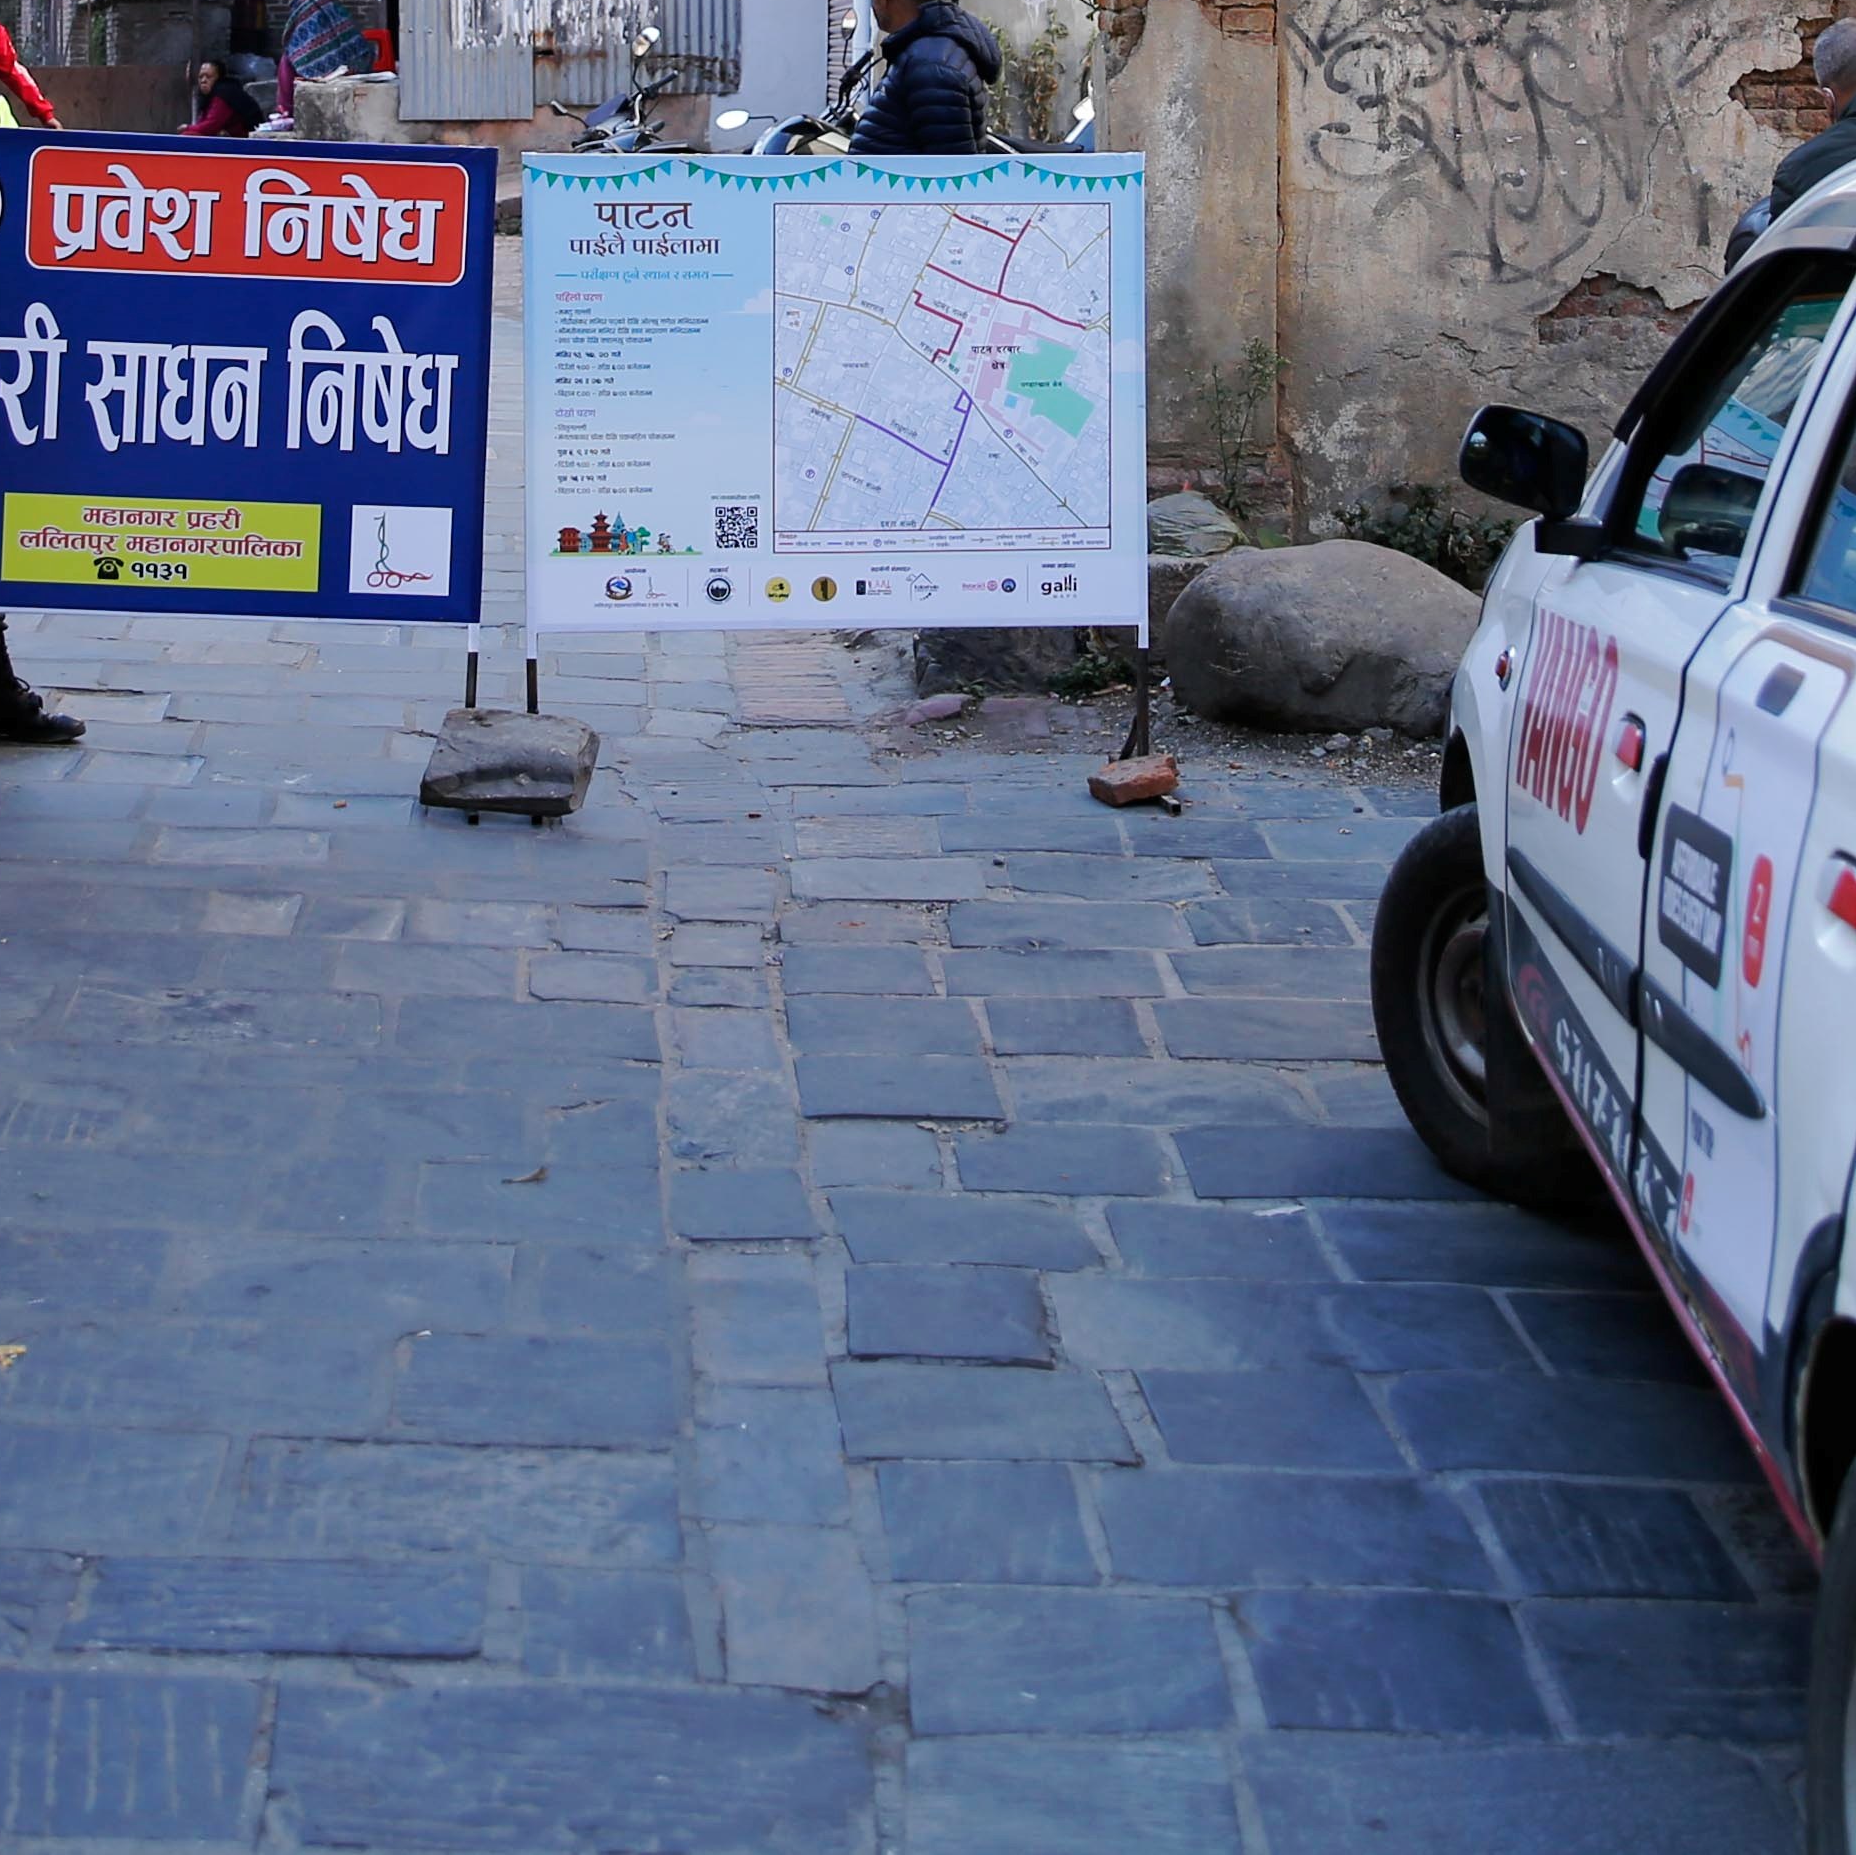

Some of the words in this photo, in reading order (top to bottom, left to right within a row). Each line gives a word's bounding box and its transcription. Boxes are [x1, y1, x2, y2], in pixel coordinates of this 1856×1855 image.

[49, 164, 220, 262] प्रवेश
[242, 167, 444, 266] निषेध
[593, 203, 694, 230] पाटन
[569, 231, 625, 257] पाईलै
[632, 231, 721, 257] पाईलामा
[971, 345, 993, 354] पाटन
[996, 345, 1021, 354] दरबार
[84, 338, 268, 454] साधन
[286, 309, 459, 456] निषेध
[82, 505, 179, 532] महानगर
[185, 505, 241, 533] प्रहरी
[19, 527, 118, 559] ललितपुर
[125, 533, 304, 561] महानगरपालिका
[129, 561, 189, 582] ११३१
[1041, 574, 1078, 596] galli
[1516, 607, 1619, 837] YANGO
